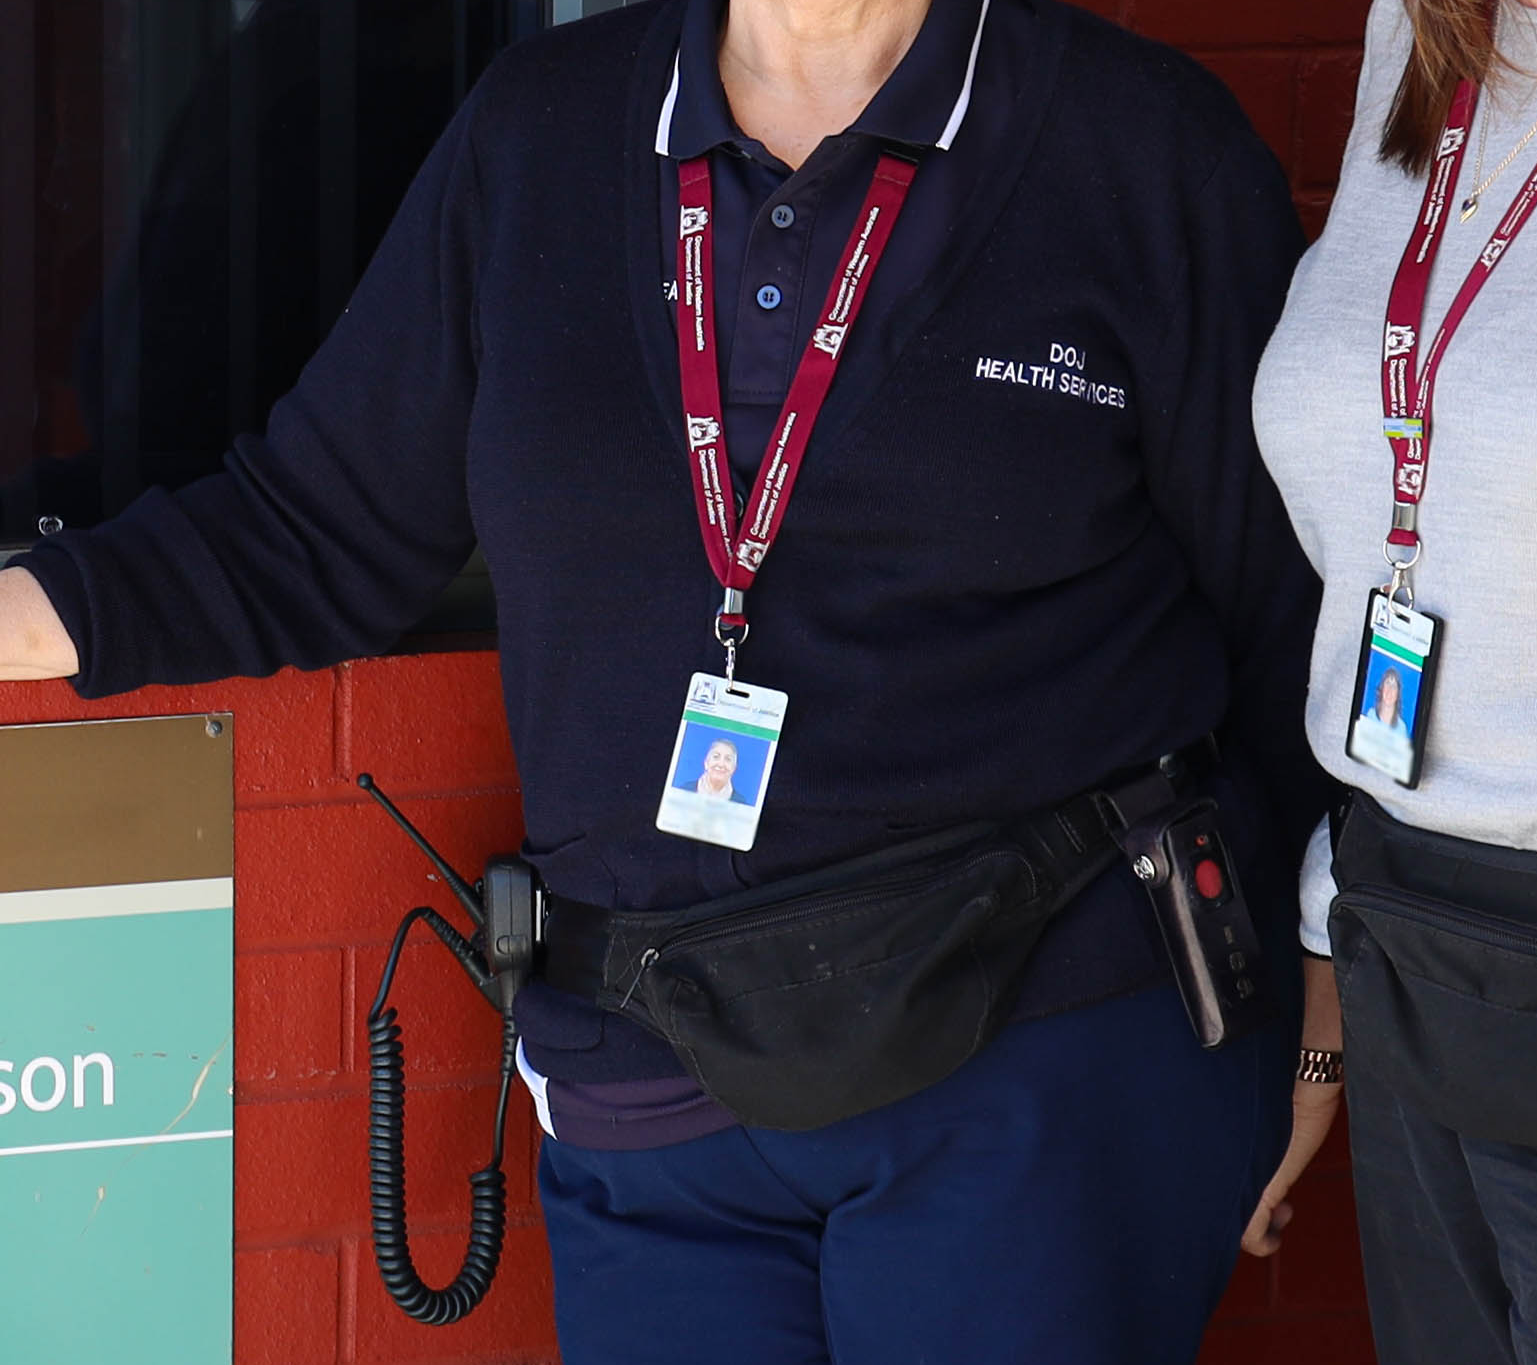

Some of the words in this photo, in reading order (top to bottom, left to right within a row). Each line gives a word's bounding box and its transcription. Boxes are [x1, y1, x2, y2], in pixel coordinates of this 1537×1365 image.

[1049, 342, 1087, 371] DOJ
[975, 357, 1056, 390] HEALTH
[1058, 372, 1126, 410] SERVICES
